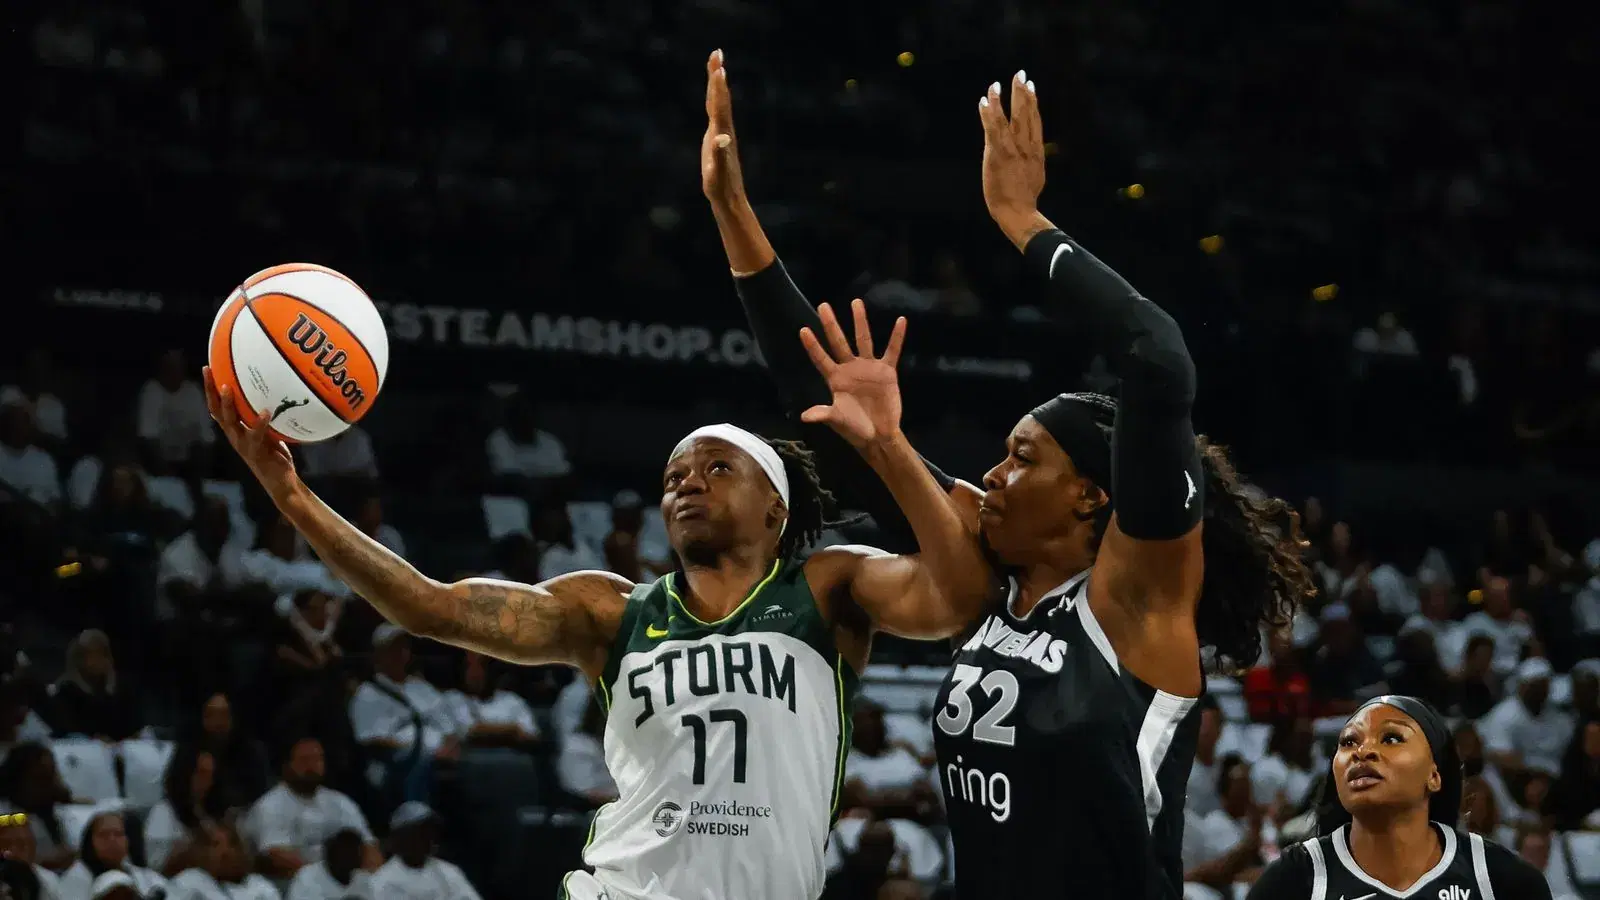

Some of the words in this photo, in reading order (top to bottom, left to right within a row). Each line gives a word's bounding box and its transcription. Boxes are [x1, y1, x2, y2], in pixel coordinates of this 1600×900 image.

[286, 311, 366, 412] Wilson
[377, 300, 764, 367] STEAMSHOP.C
[627, 641, 797, 729] STORM
[935, 663, 1020, 746] 32
[681, 708, 748, 785] 17
[689, 800, 772, 818] Providence
[946, 754, 1011, 823] ring
[687, 821, 750, 837] SWEDISH
[1437, 884, 1472, 900] ally
